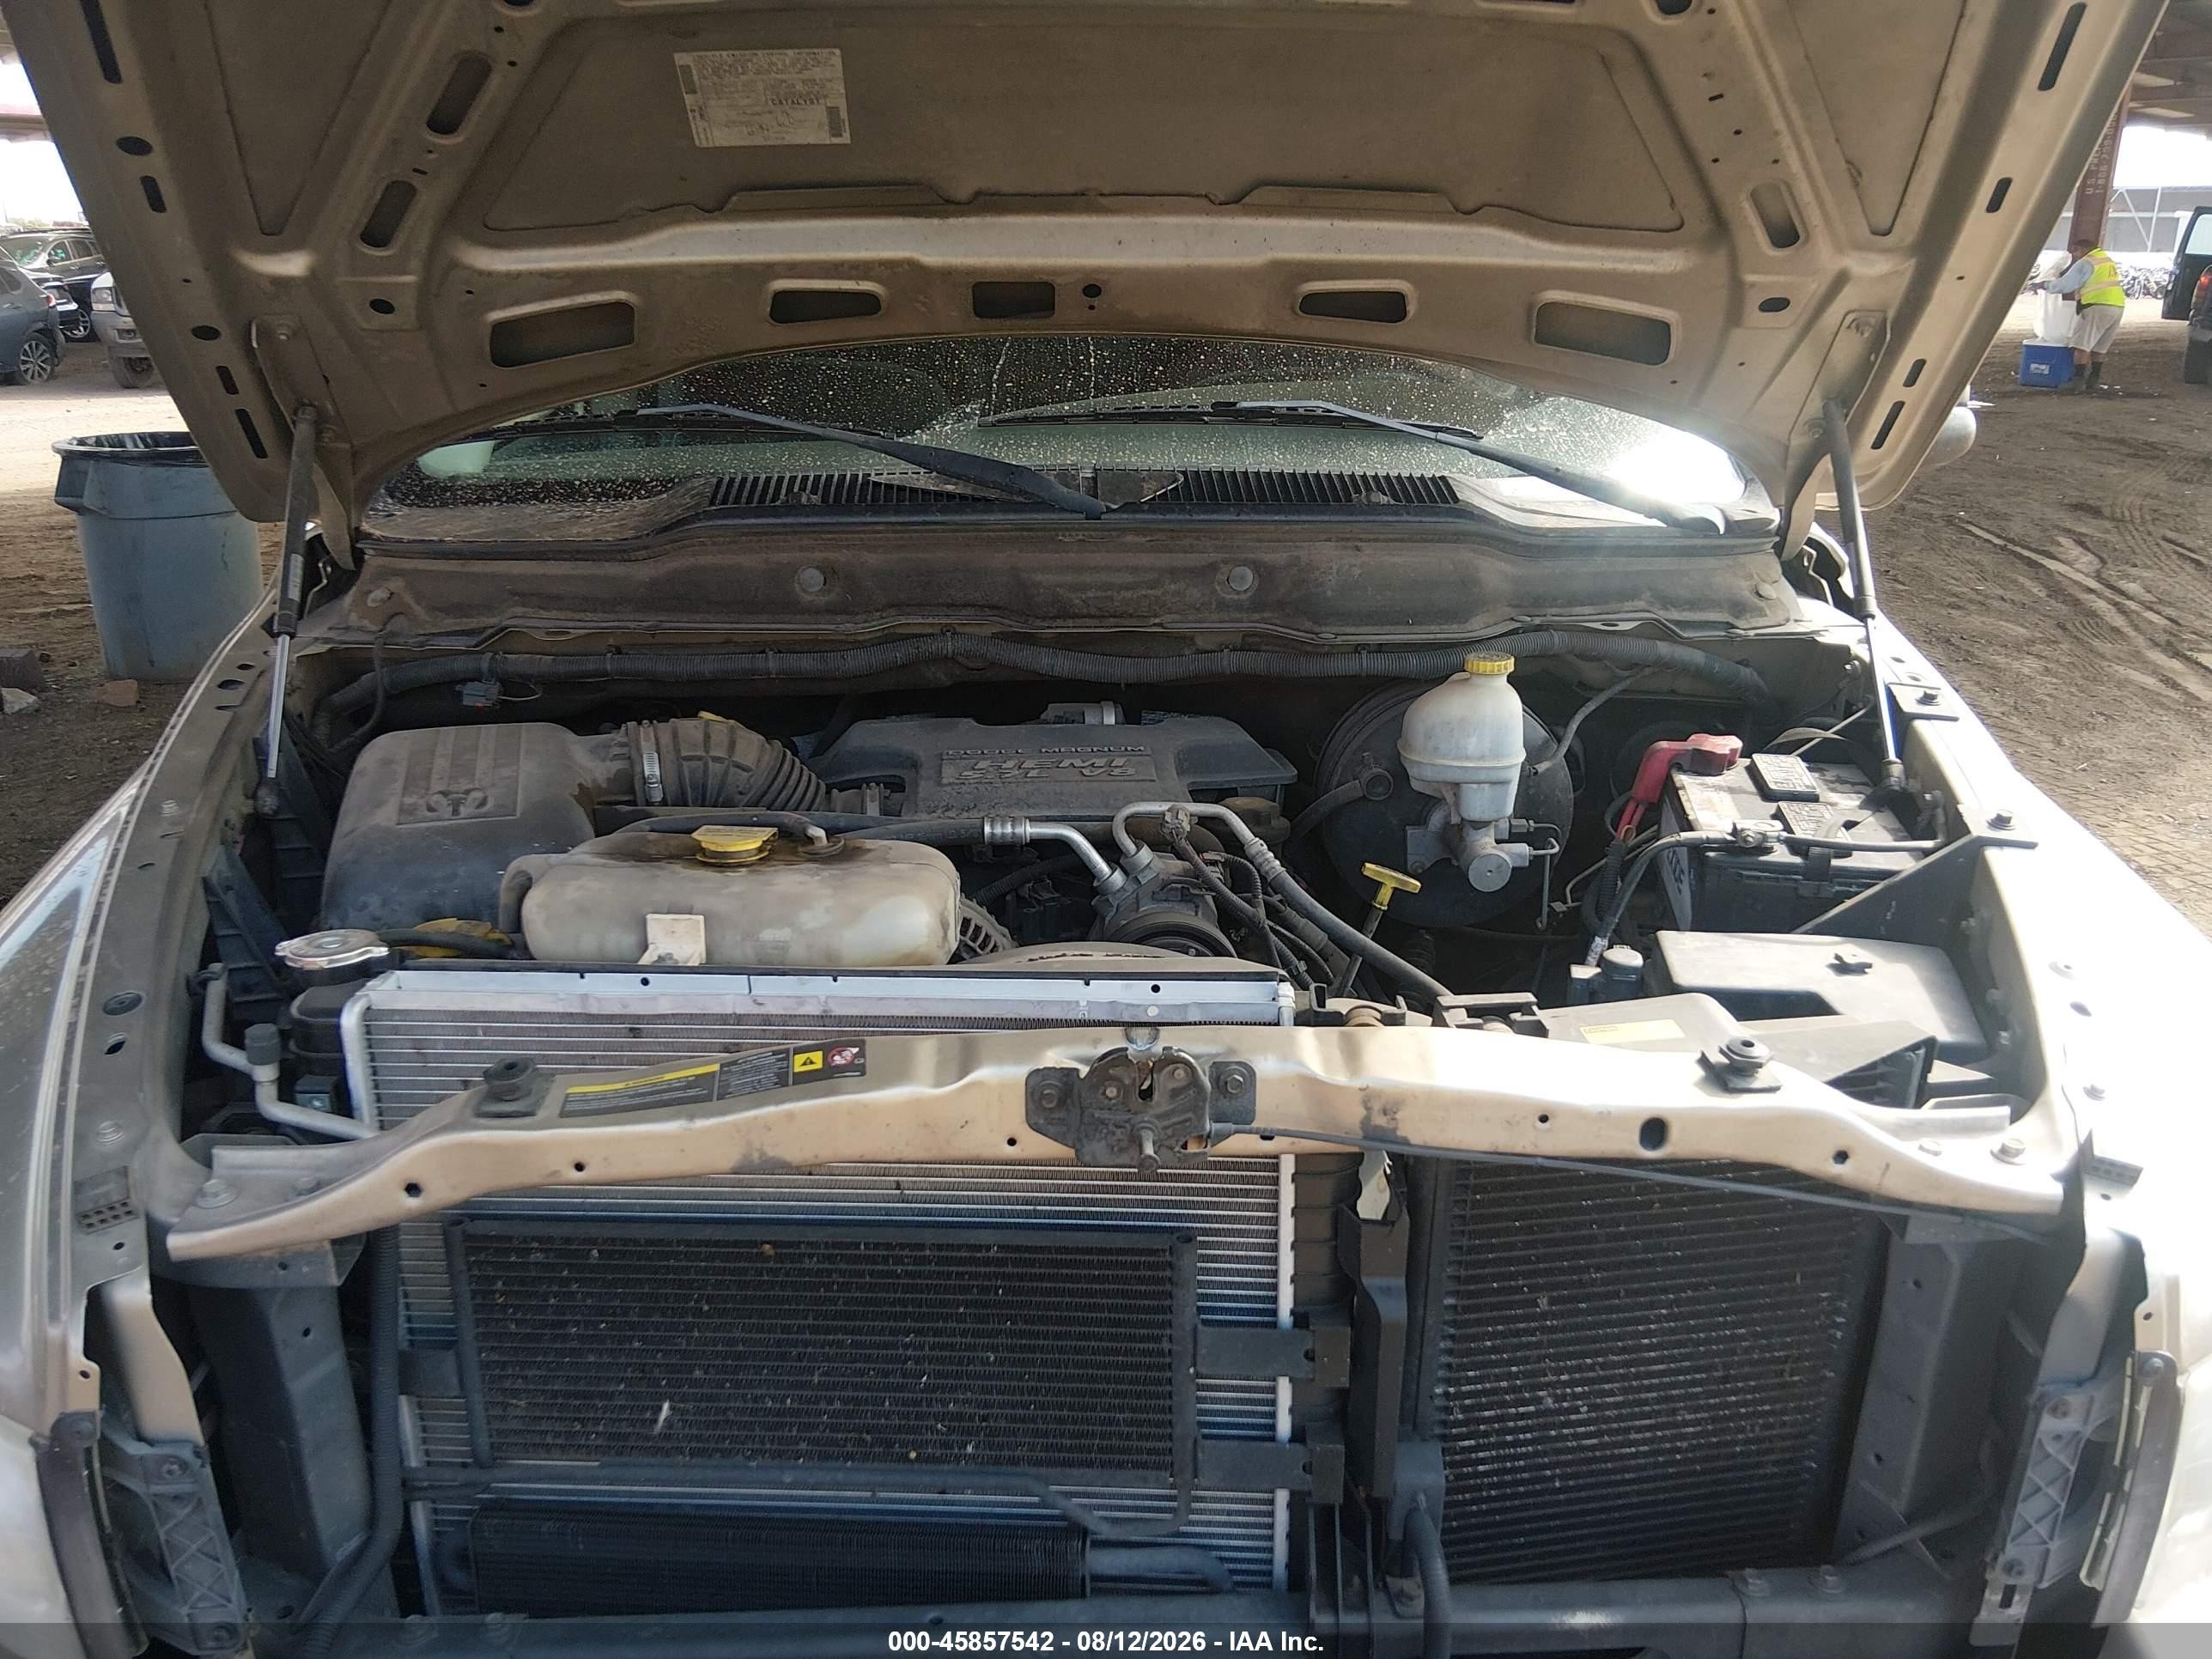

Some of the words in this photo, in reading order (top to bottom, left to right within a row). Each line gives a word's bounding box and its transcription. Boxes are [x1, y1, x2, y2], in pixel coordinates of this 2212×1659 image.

[1040, 745, 1146, 754] MAGNUM
[973, 757, 1130, 769] HEMI
[957, 768, 1049, 780] 5.7L
[1080, 768, 1138, 777] V8
